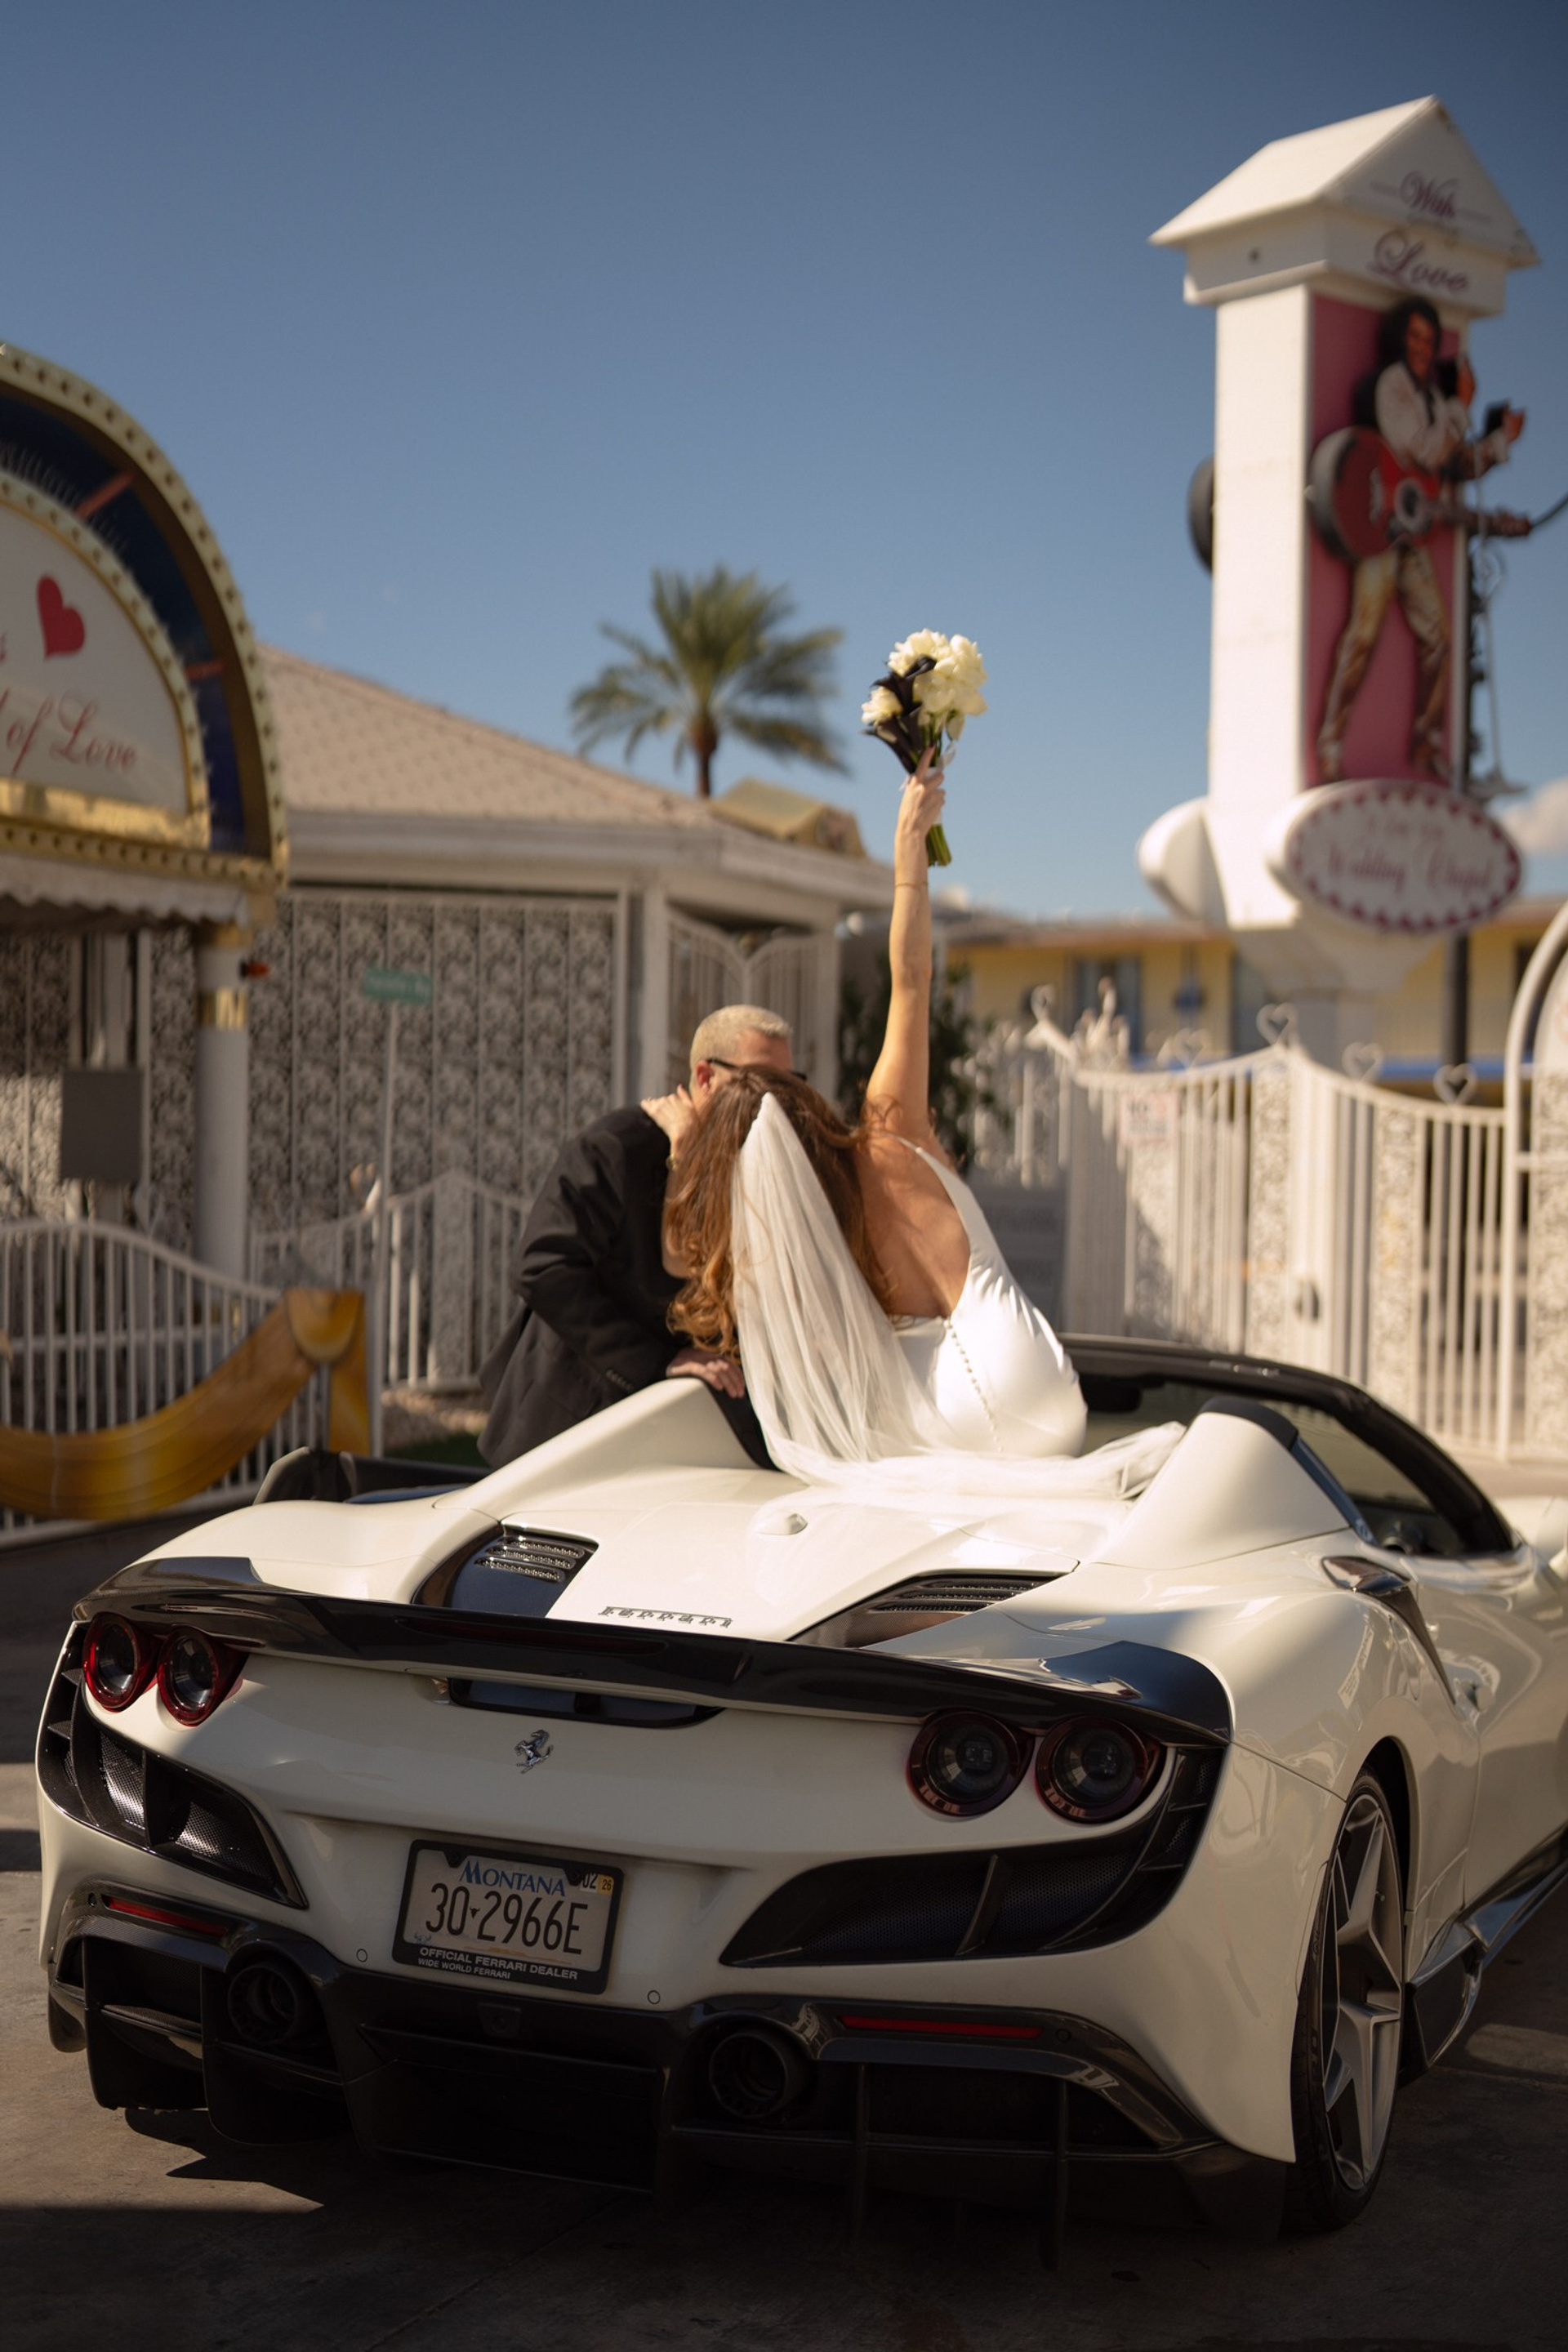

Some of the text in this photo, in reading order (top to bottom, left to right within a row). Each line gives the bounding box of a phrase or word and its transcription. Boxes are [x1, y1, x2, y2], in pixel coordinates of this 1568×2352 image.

[1366, 228, 1468, 290] Love
[7, 690, 136, 777] of Love
[459, 1860, 566, 1897] MONTANA
[602, 1879, 612, 1891] 26
[418, 1958, 510, 1980] WIDE WORLD FERRARI
[420, 1947, 578, 1980] OFFICIAL FERRARI DEALER
